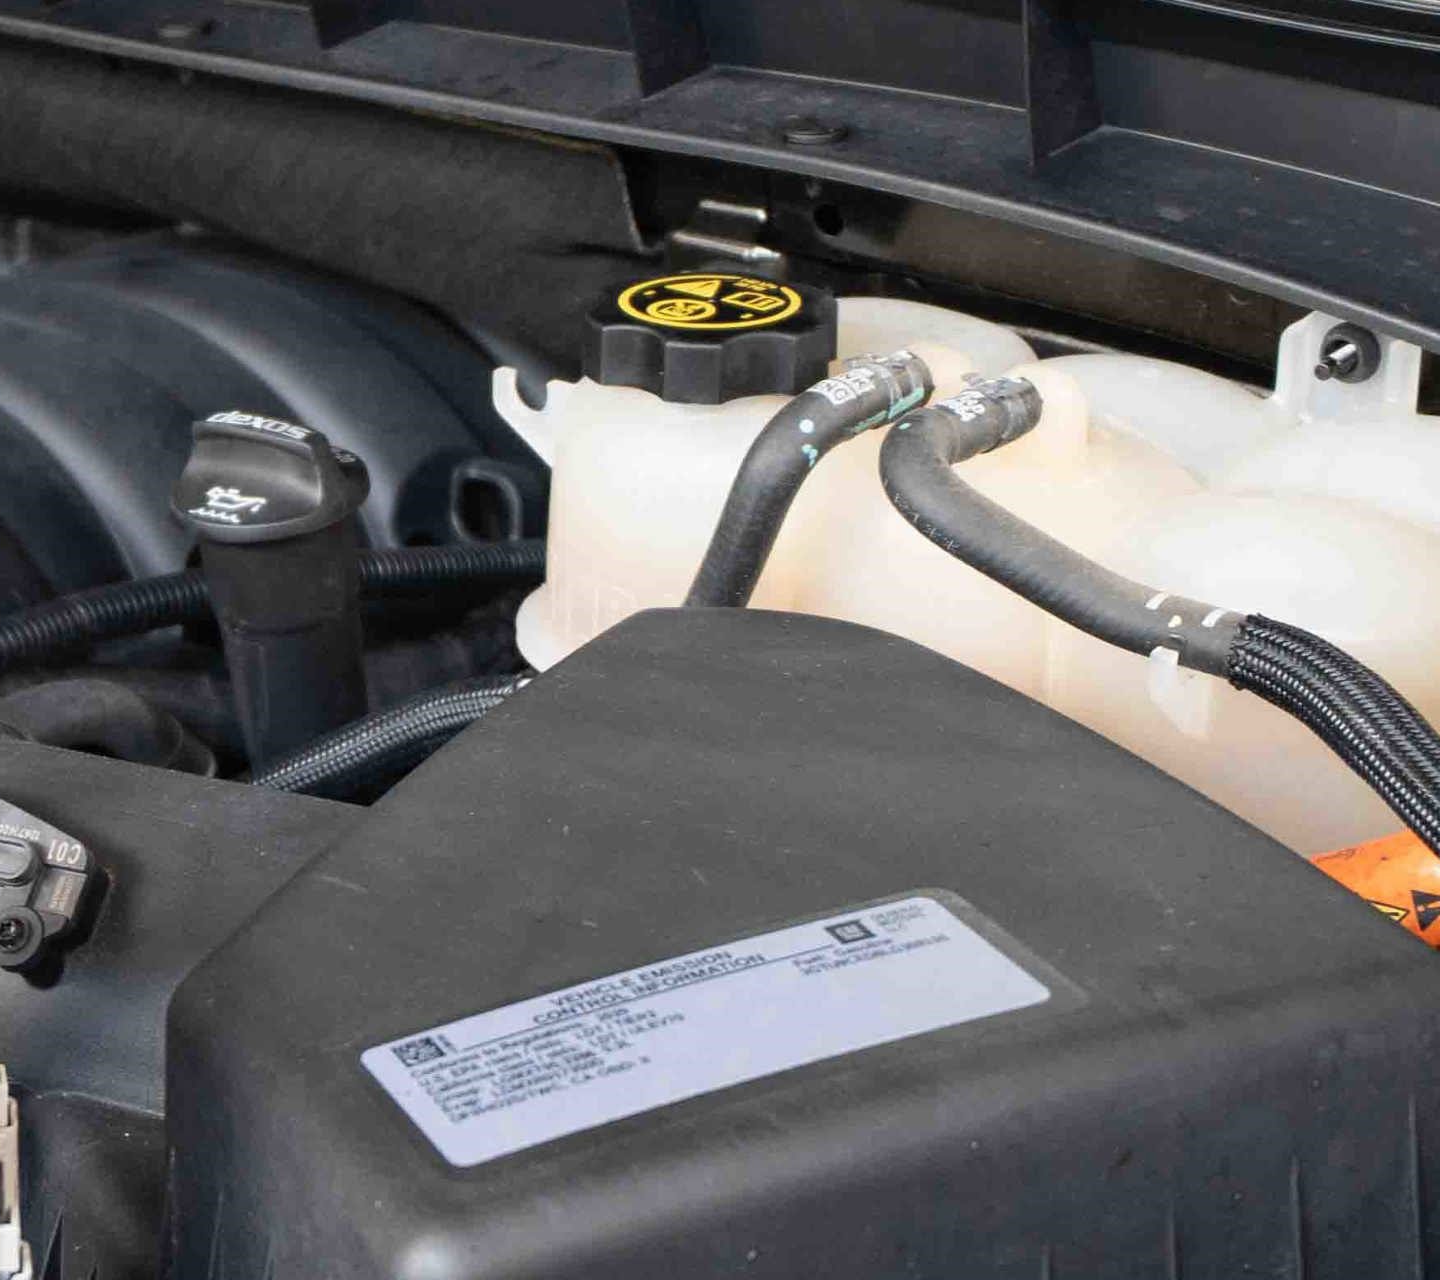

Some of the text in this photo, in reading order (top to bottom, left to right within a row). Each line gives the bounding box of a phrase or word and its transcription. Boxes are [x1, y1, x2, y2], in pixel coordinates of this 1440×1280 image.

[205, 411, 315, 439] dexos
[532, 991, 631, 1024] CONTROL
[630, 953, 766, 997] INFORMATION
[549, 951, 732, 1007] VEHICLE EMISSION
